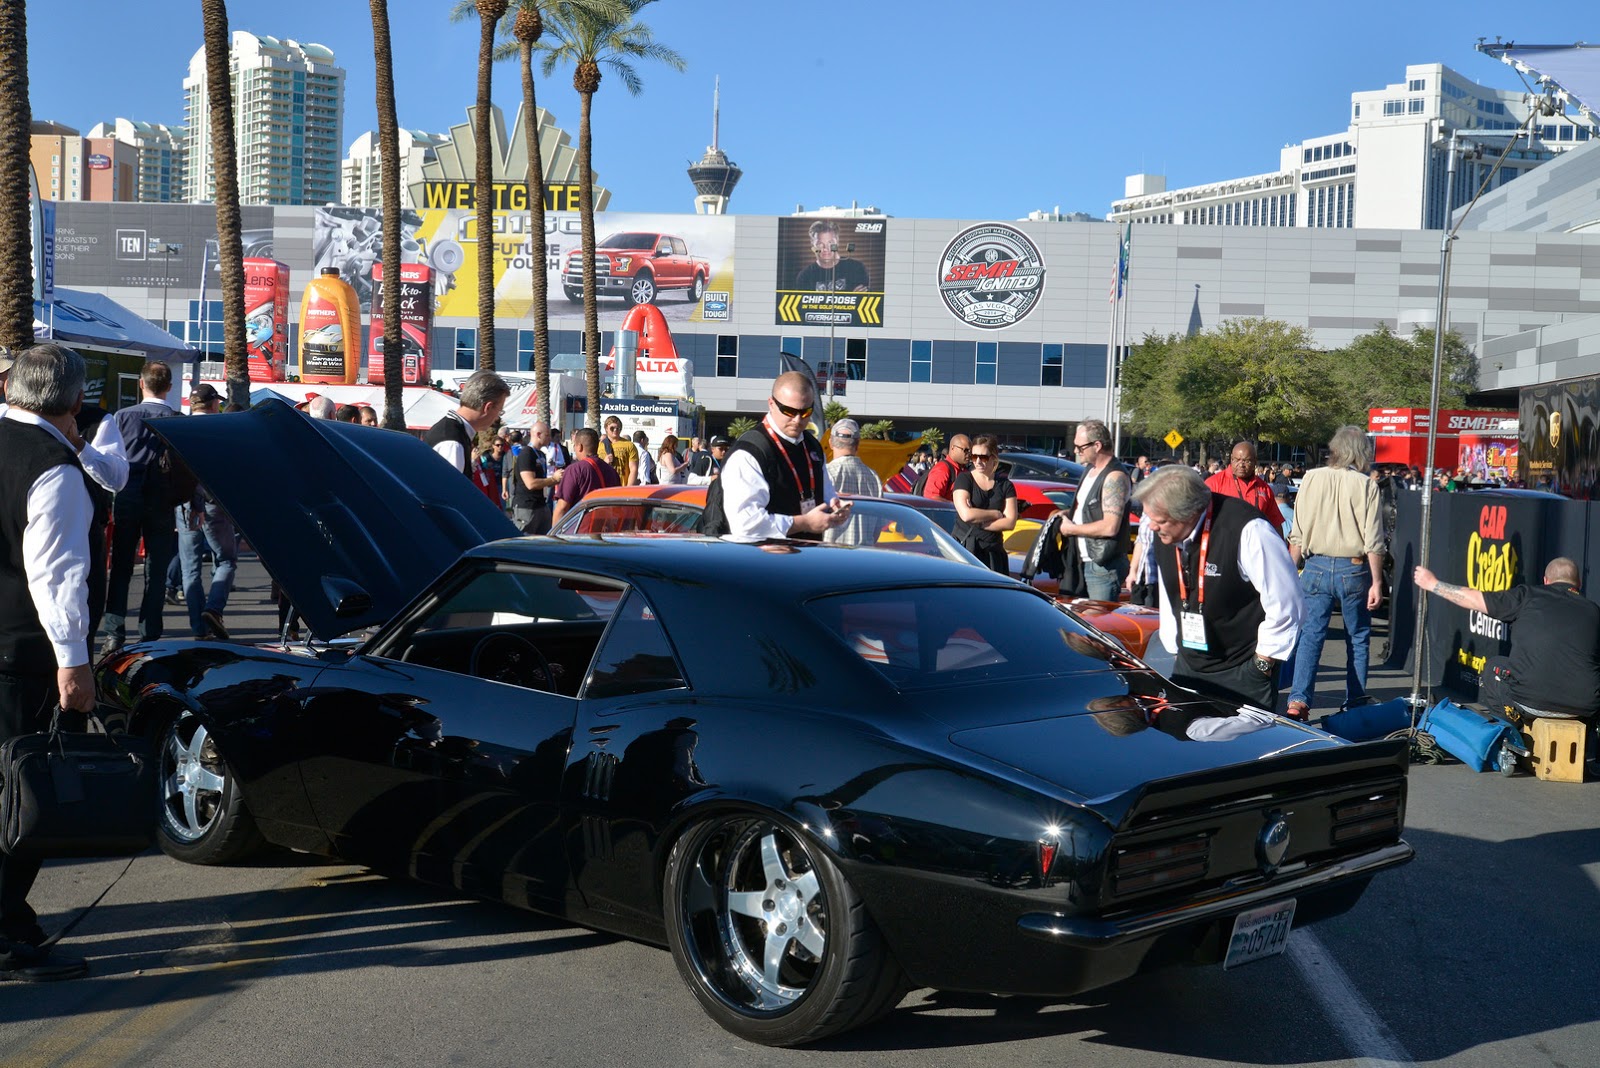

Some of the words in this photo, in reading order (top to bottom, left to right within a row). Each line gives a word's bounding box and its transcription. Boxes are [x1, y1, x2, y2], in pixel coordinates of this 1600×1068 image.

[855, 223, 883, 231] SEMA
[993, 228, 1012, 237] MARKET
[121, 237, 140, 253] TEN
[945, 260, 1019, 282] SEMA
[975, 275, 1039, 292] IGNITED
[705, 293, 727, 302] BUILT
[802, 295, 824, 304] CHIP
[705, 310, 727, 318] TOUGH
[969, 303, 984, 311] LAS
[986, 303, 1012, 312] VEGAS
[604, 360, 678, 373] AALTA
[604, 403, 629, 411] Axalta
[631, 404, 672, 413] Experience
[1448, 416, 1487, 430] SEMA
[1479, 504, 1507, 540] CAR
[1466, 530, 1518, 592] Crazy
[1469, 608, 1509, 641] Central
[1239, 915, 1271, 930] WASHINGTON
[1248, 920, 1288, 955] 05744
